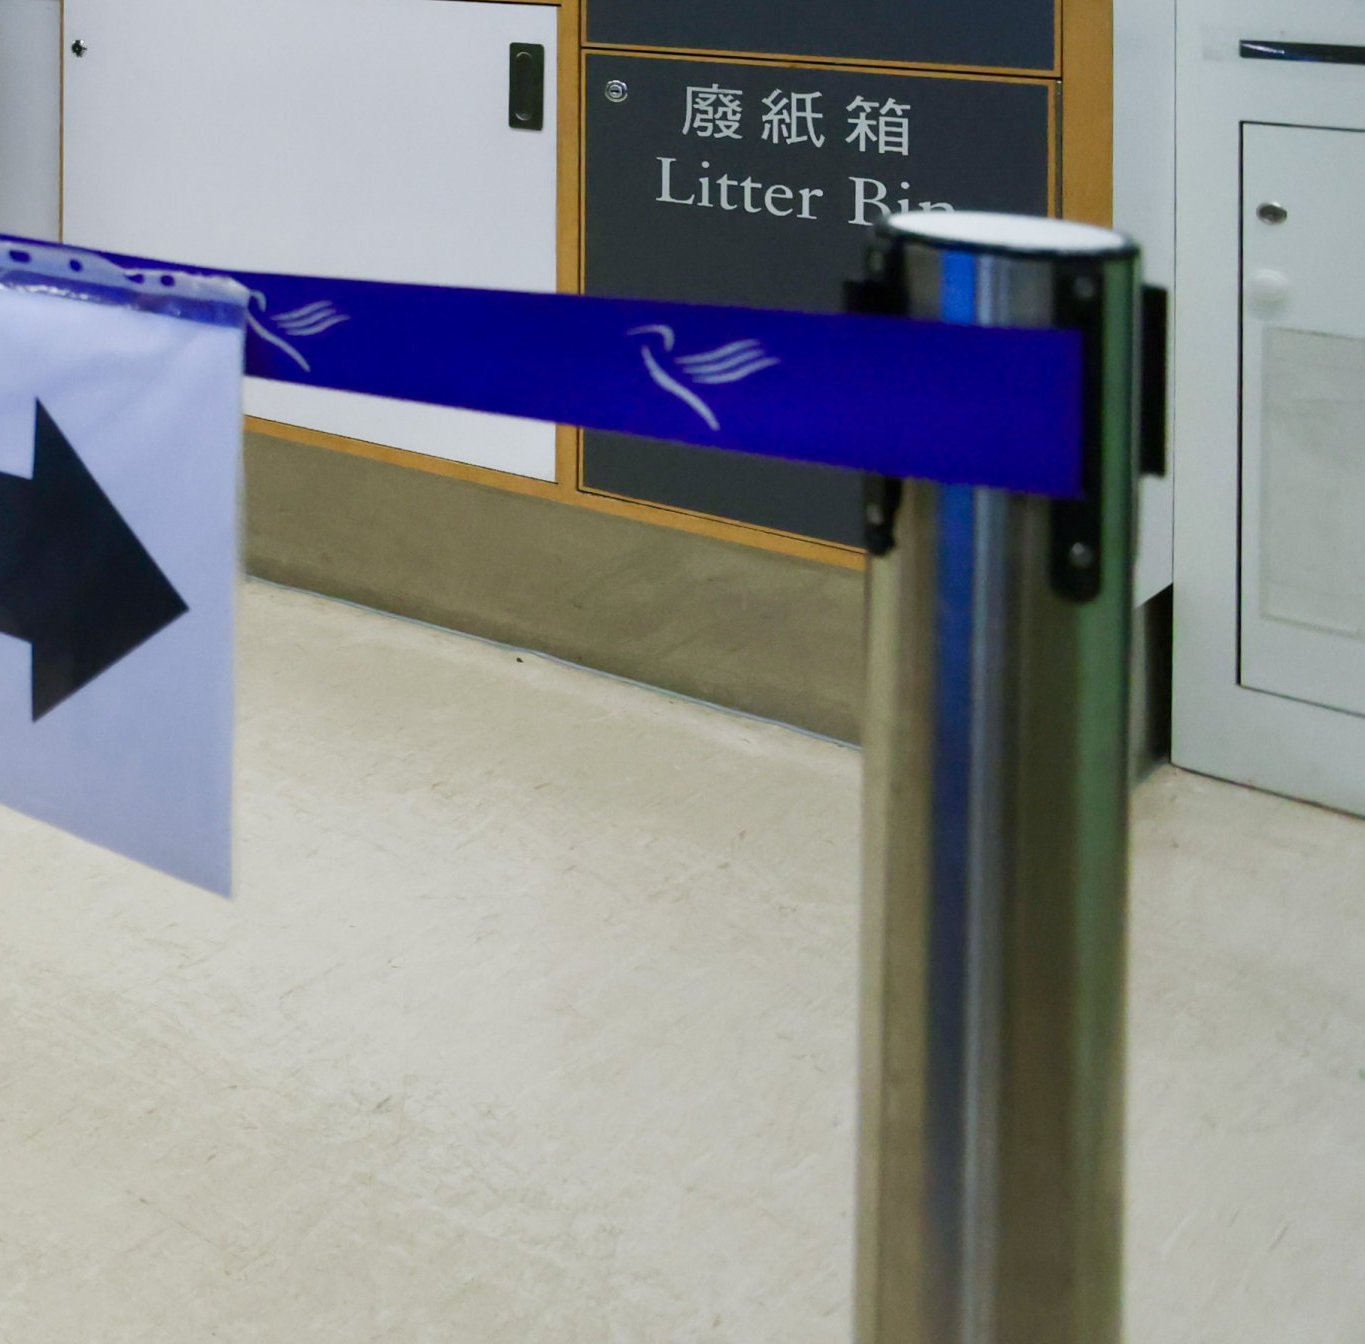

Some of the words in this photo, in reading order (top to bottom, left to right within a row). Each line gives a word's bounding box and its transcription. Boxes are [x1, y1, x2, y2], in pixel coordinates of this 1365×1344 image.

[682, 83, 911, 156] 廢紙箱
[655, 156, 824, 220] Litter
